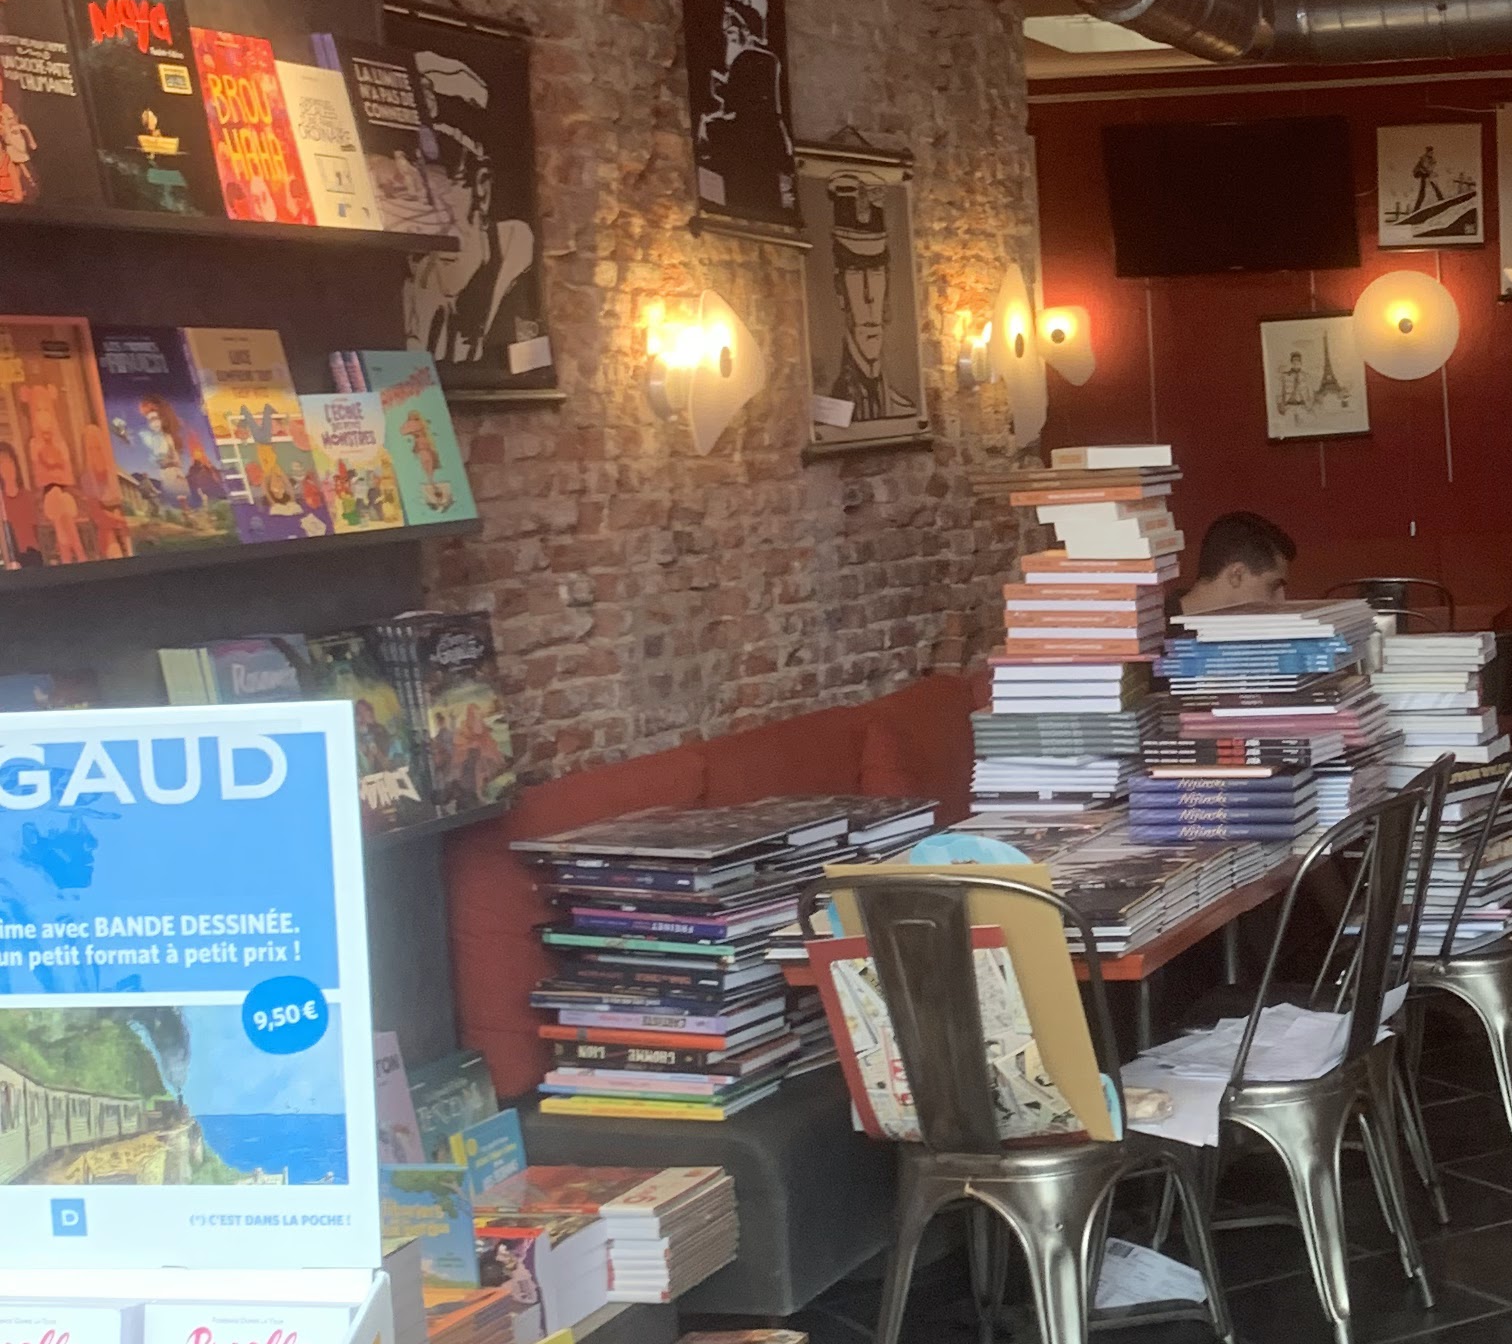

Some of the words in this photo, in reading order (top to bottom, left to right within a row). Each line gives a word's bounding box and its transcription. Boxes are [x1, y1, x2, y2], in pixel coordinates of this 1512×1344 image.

[207, 74, 273, 126] BROU
[223, 127, 289, 185] HAHA
[41, 922, 89, 939] avec
[95, 916, 175, 938] BANDE
[181, 908, 300, 936] DESSINÉE.
[29, 944, 80, 971] petit
[85, 943, 160, 966] format
[166, 943, 180, 963] à
[184, 941, 238, 968] petit
[243, 940, 288, 967] prix
[208, 1214, 242, 1227] C'EST
[245, 1214, 280, 1227] DANS
[283, 1214, 298, 1226] LA
[301, 1214, 344, 1227] POCHE
